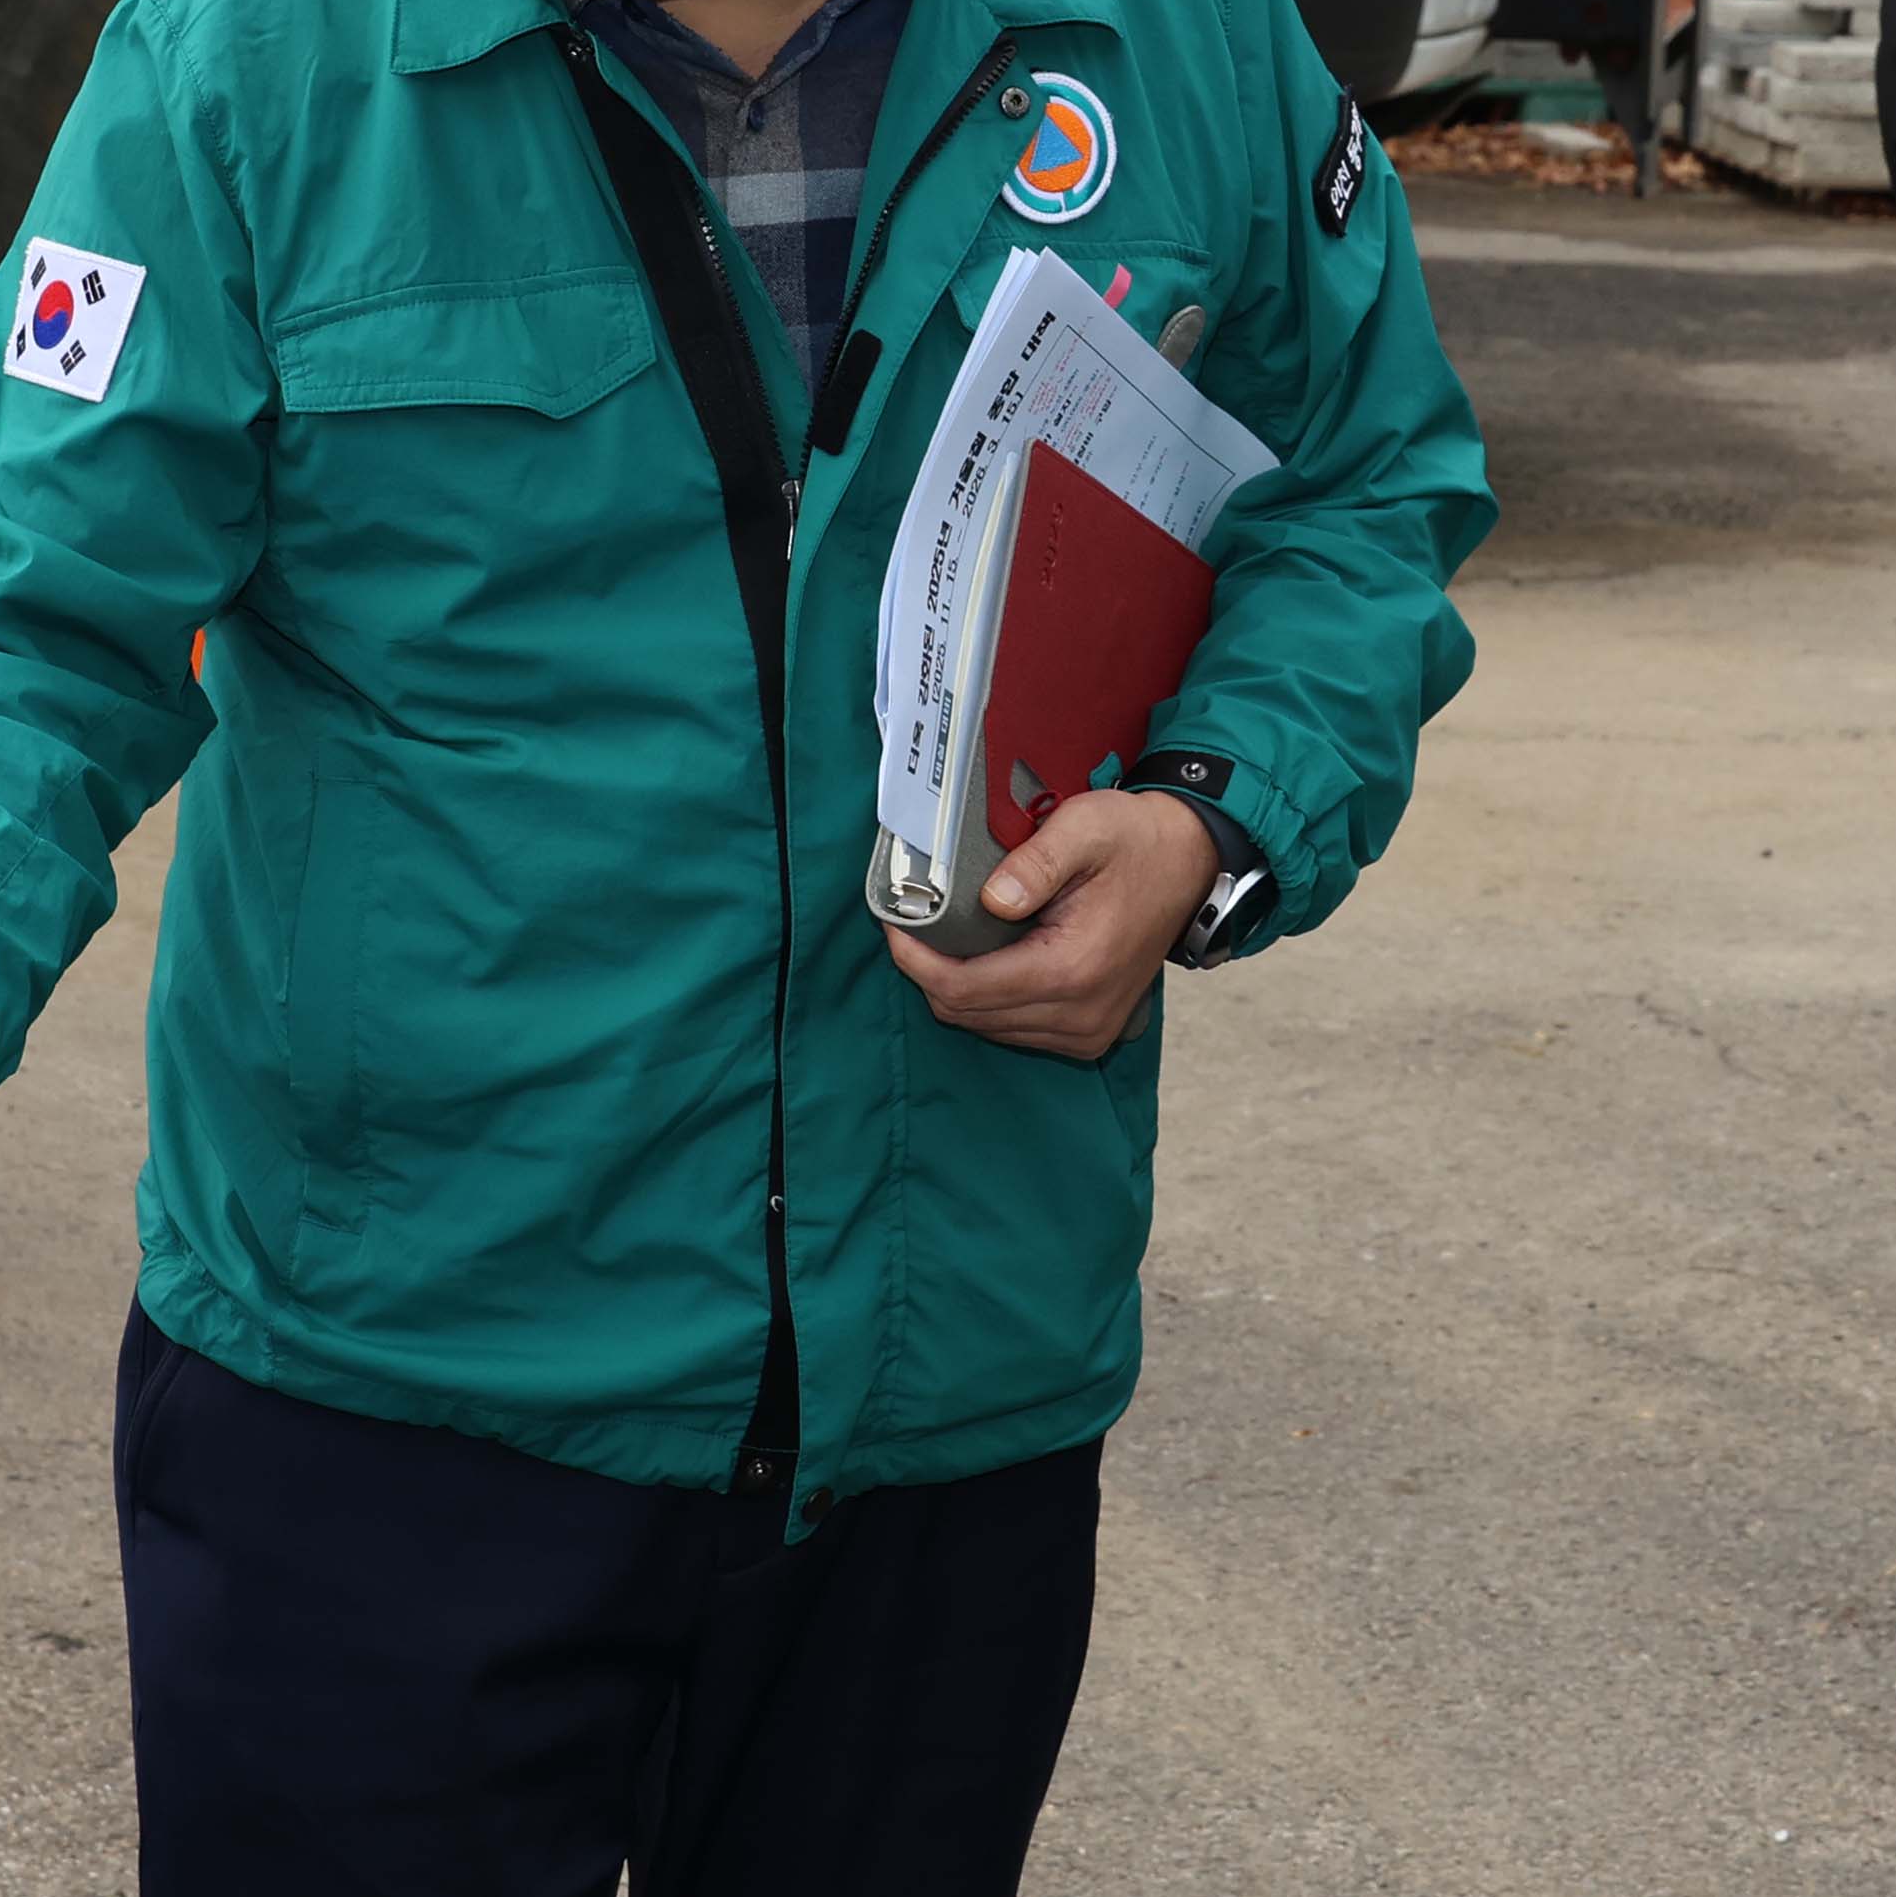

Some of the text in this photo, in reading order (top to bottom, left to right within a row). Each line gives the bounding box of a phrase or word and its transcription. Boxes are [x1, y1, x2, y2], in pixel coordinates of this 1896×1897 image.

[1330, 159, 1355, 220] 인천
[1020, 310, 1057, 362] 대책
[987, 369, 1021, 422] 종합
[948, 431, 988, 511] 겨울철
[987, 437, 1002, 454] 3.
[962, 464, 989, 520] 2026.
[926, 520, 953, 615] 2025년
[945, 556, 959, 583] 15.
[940, 599, 951, 625] 11.
[918, 623, 935, 706] 강화된
[906, 719, 925, 776] 더욱
